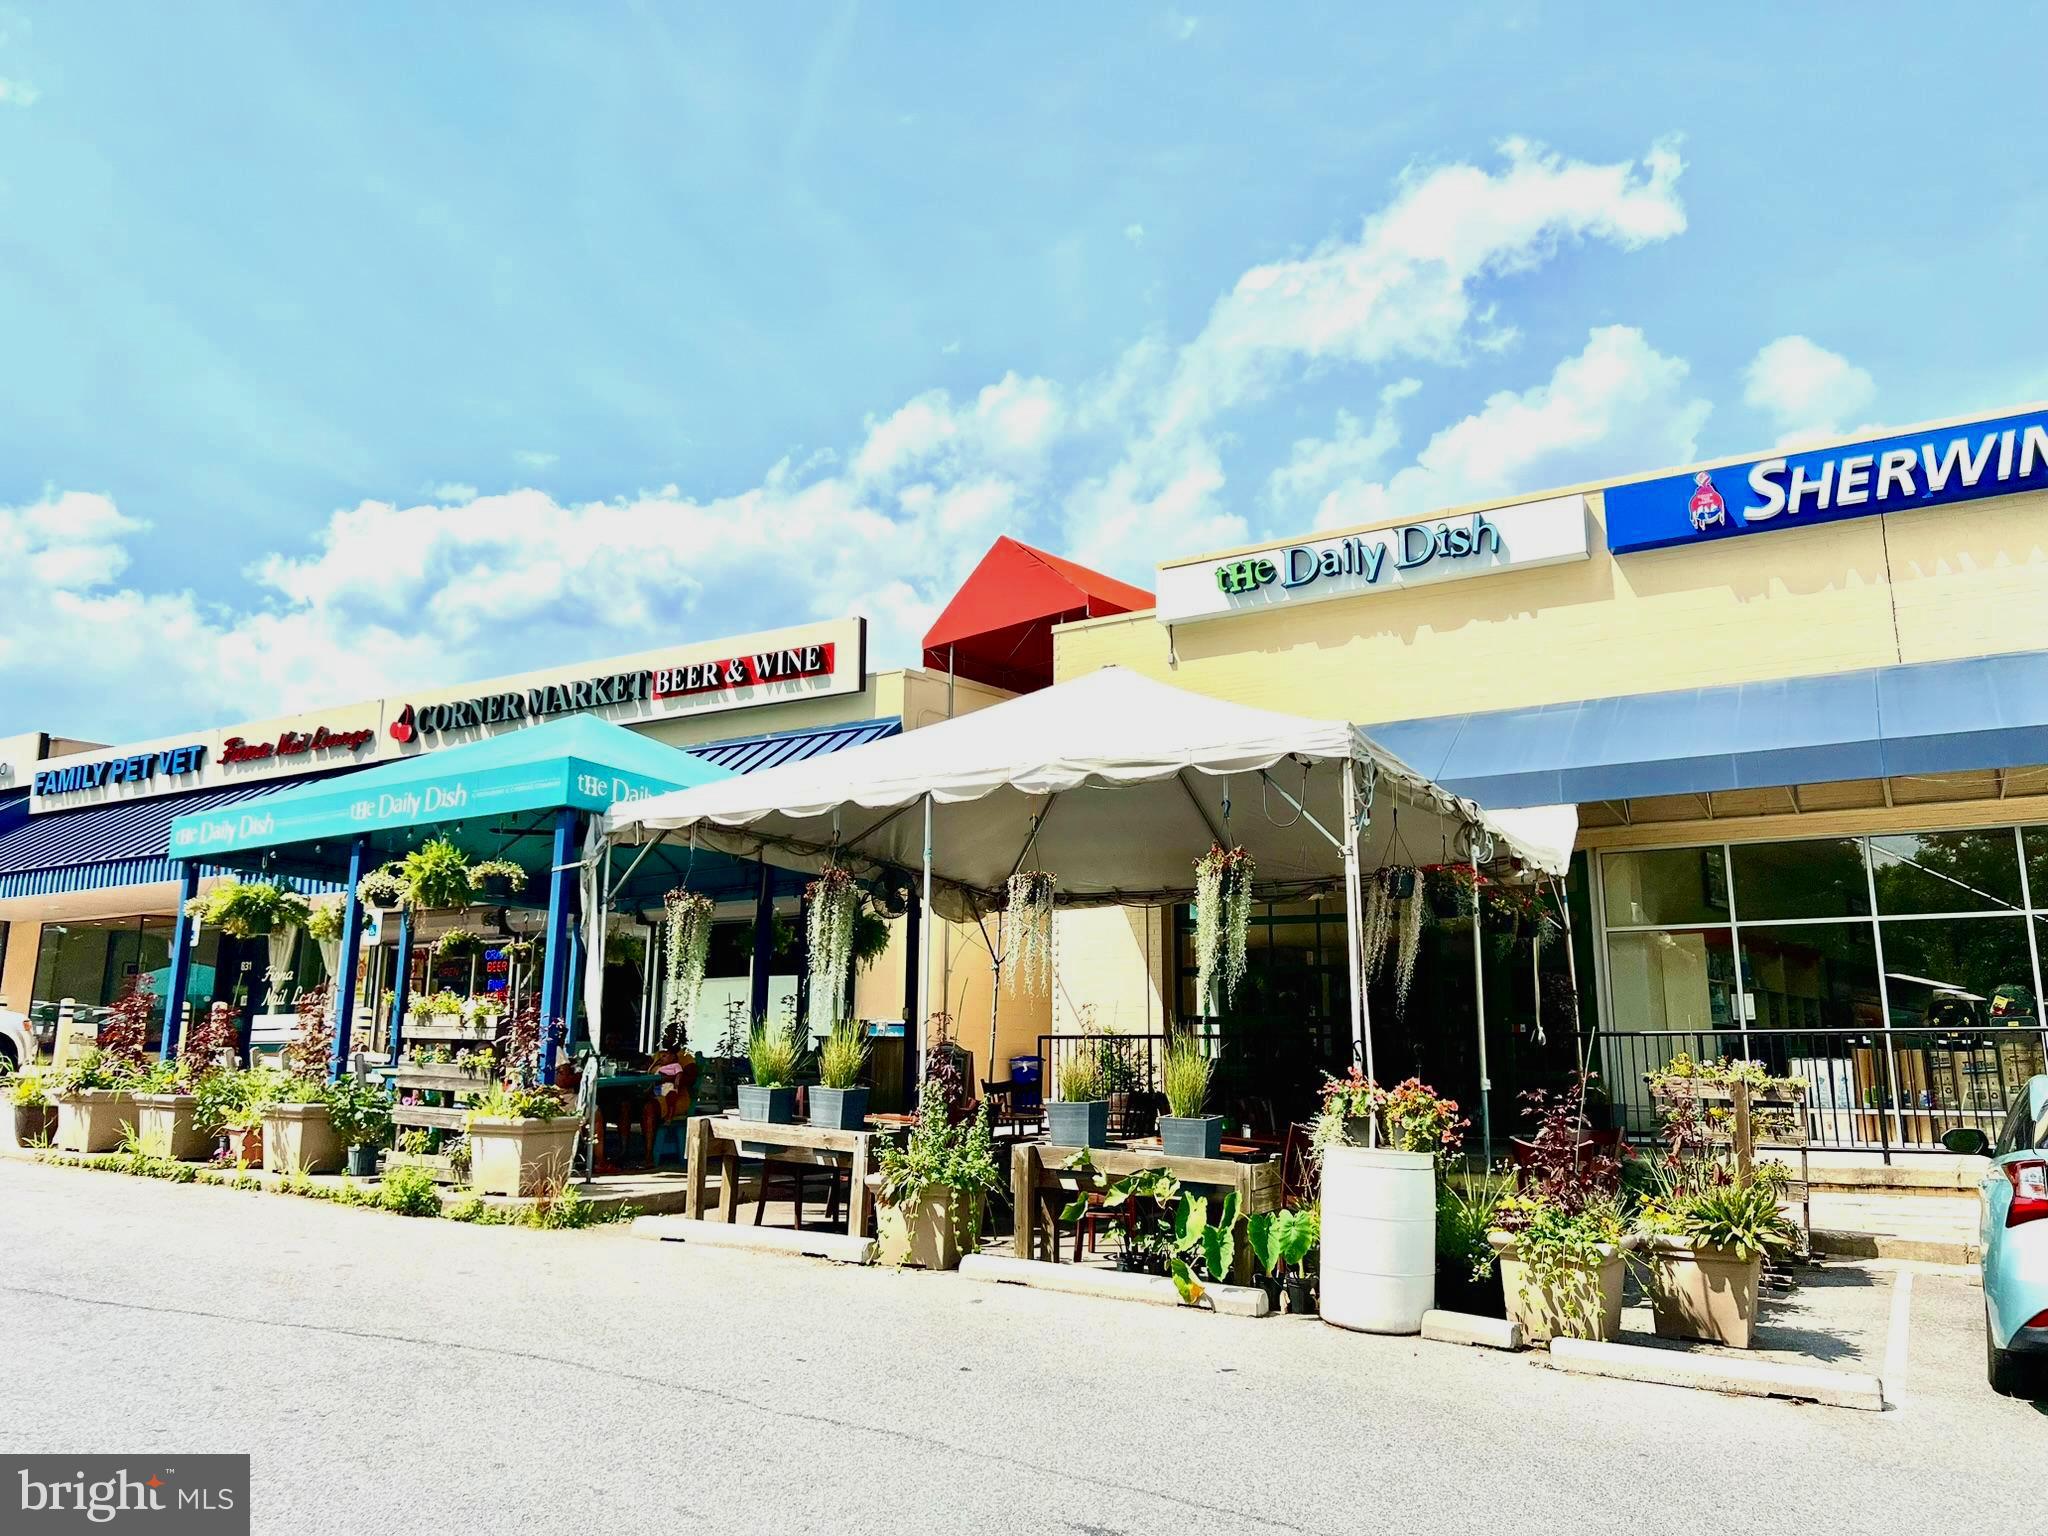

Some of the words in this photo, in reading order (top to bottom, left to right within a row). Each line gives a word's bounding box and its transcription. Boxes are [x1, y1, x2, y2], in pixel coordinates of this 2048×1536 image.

[1281, 545, 1387, 588] Daily
[1393, 512, 1499, 569] Dish
[415, 692, 523, 734] CORNER
[528, 670, 652, 716] MARKET
[655, 662, 719, 694] BEER
[724, 658, 745, 684] &
[751, 645, 822, 679] WINE
[34, 761, 109, 797] FAMILY
[110, 753, 156, 784] PET
[158, 745, 206, 776] VET
[377, 793, 423, 820] Daily
[423, 782, 467, 813] Dish
[200, 819, 237, 846] Daily
[239, 812, 275, 839] Dish
[261, 965, 295, 982] Fiona
[487, 961, 508, 973] BEER
[261, 987, 288, 1007] Nail
